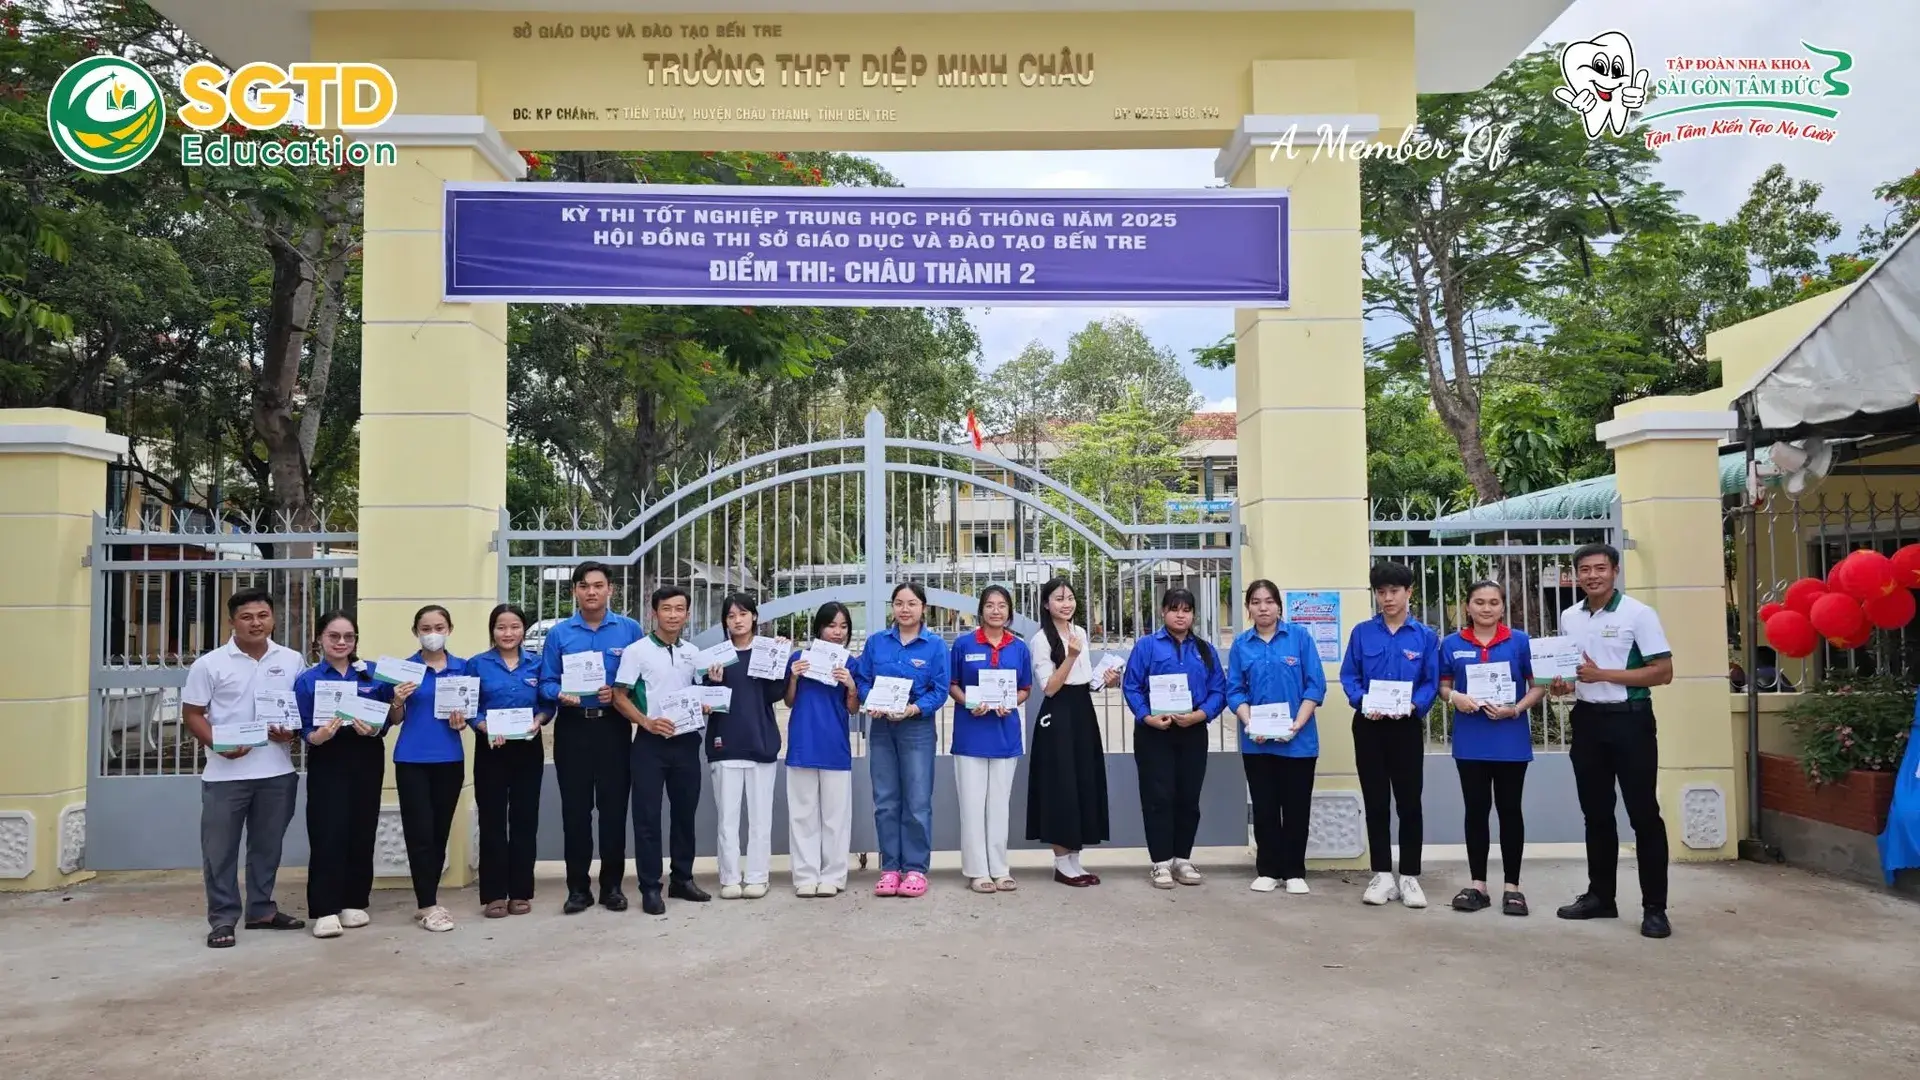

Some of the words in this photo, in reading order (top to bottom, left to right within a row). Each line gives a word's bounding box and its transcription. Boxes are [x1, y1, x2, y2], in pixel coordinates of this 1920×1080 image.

[538, 23, 574, 39] GIÁO
[580, 25, 610, 41] DỤC
[616, 23, 636, 38] VÀ
[642, 23, 673, 39] ĐÀO
[680, 25, 709, 40] TẠO
[716, 21, 746, 38] BẾN
[752, 25, 782, 37] TRE
[643, 44, 766, 87] TRƯỜNG
[775, 54, 850, 87] THPT
[861, 46, 927, 93] DIỆP
[937, 54, 1008, 87] MINH
[1018, 46, 1095, 87] CHÂU
[513, 108, 531, 120] ĐC:
[536, 108, 552, 120] KP
[875, 109, 897, 121] TRE
[561, 206, 590, 223] KỲ
[598, 208, 635, 223] THI
[643, 204, 687, 224] TỐT
[694, 207, 779, 227] NGHIỆP
[786, 211, 862, 226] TRUNG
[870, 211, 916, 229] HỌC
[925, 207, 972, 227] PHỔ
[979, 210, 1055, 227] THÔNG
[1063, 210, 1113, 227] NĂM
[1121, 213, 1177, 227] 2025
[593, 228, 634, 248] HỘI
[641, 226, 706, 247] ĐỒNG
[713, 232, 750, 247] THI
[758, 230, 788, 247] SỞ
[796, 230, 850, 248] GIÁO
[858, 234, 904, 251] DỤC
[912, 231, 942, 249] VÀ
[949, 231, 995, 249] ĐÀO
[1002, 235, 1046, 252] TẠO
[1054, 230, 1097, 249] BẾN
[1105, 235, 1147, 249] TRE
[709, 252, 778, 282] ĐIỂM
[786, 260, 836, 283] THI:
[845, 257, 916, 283] CHÂU
[924, 257, 1011, 284] THÀNH
[1019, 263, 1036, 284] 2
